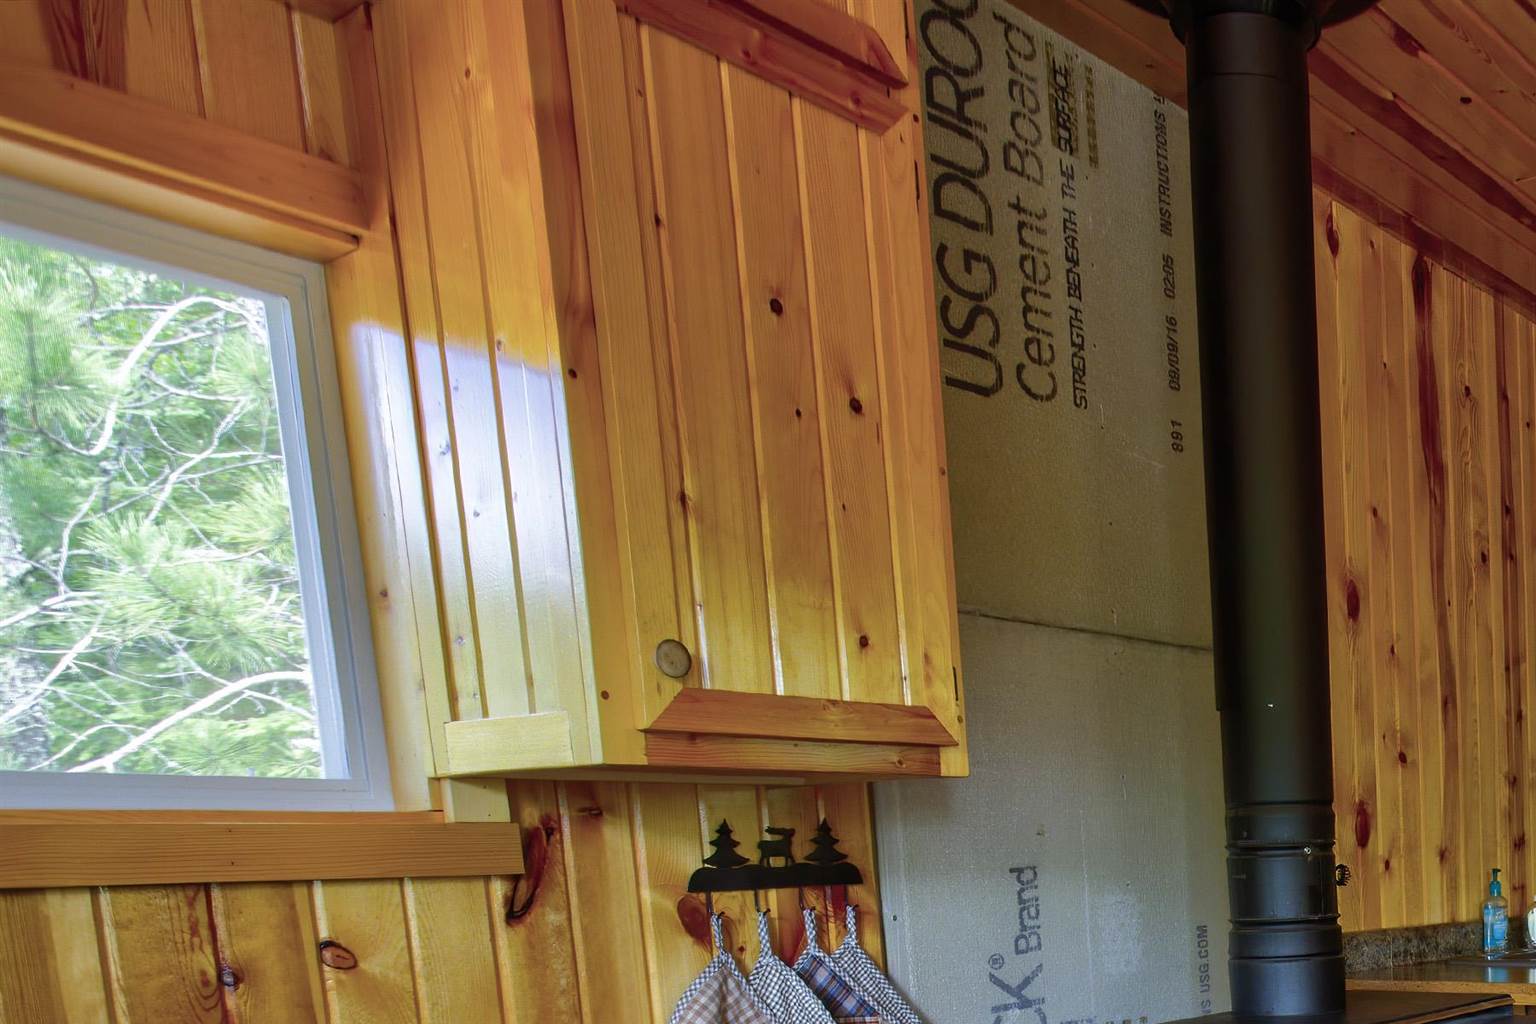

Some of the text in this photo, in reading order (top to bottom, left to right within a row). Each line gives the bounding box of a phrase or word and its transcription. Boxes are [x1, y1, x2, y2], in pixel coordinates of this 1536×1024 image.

[919, 0, 1003, 398] USG DURO
[992, 11, 1058, 404] Cement Board
[1052, 55, 1088, 410] STRENGTH BENEATH THE SURFACE
[1153, 108, 1173, 238] INSTRUCTIONS
[1170, 419, 1185, 453] 891
[1008, 865, 1042, 958] Brand
[1196, 925, 1211, 994] USG.COM
